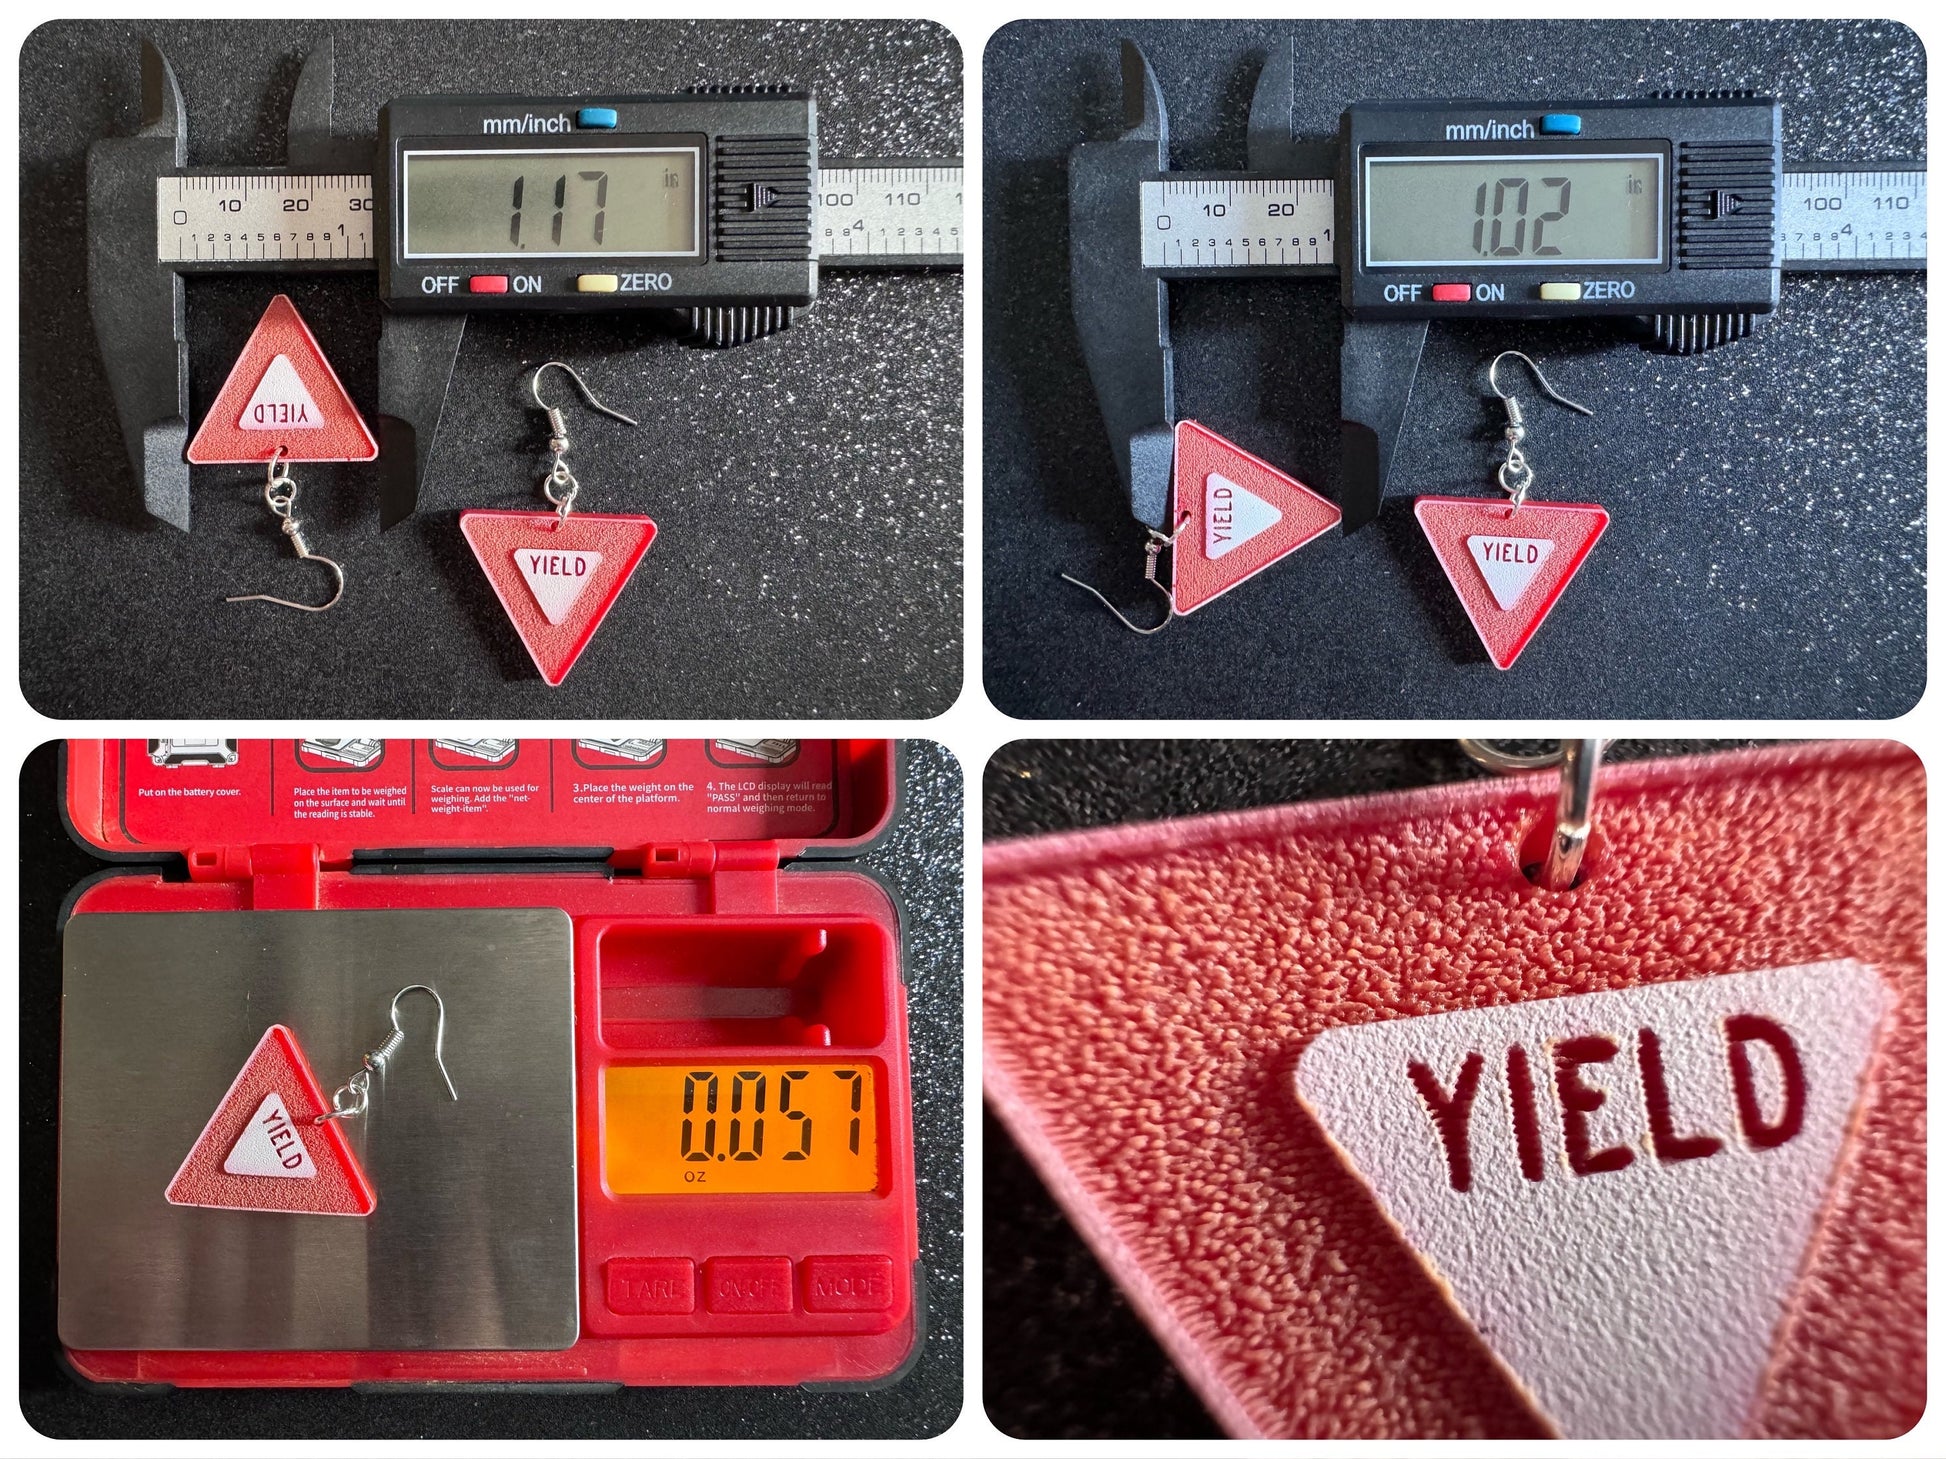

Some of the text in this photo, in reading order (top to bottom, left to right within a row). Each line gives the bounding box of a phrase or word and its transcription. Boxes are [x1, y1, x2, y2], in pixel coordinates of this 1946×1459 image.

[484, 114, 571, 133] mm/inch
[1446, 120, 1535, 140] mm/inch
[219, 199, 373, 212] 10 20 30
[819, 194, 853, 206] 100
[885, 193, 920, 205] 110
[1804, 197, 1908, 210] 100 110
[174, 210, 187, 224] 0
[510, 171, 608, 249] 1.17
[1203, 204, 1294, 216] 10 20
[1472, 178, 1571, 257] 1.02
[853, 220, 864, 231] 4
[1157, 215, 1171, 230] 0
[258, 233, 264, 241] 5
[338, 224, 345, 236] 1
[1259, 238, 1265, 246] 6
[1276, 238, 1282, 246] 7
[1292, 238, 1299, 246] 8
[1324, 229, 1330, 241] 1
[1796, 233, 1803, 241] 7
[1841, 224, 1852, 235] 4
[1886, 232, 1892, 240] 2
[1903, 232, 1910, 240] 3
[422, 273, 672, 294] OFF ON ZERO
[1384, 281, 1635, 302] OFF ON ZERO
[254, 403, 309, 422] YIELD
[1213, 487, 1233, 544] YIELD
[1483, 542, 1539, 564] YIELD
[530, 555, 587, 576] YIELD
[168, 788, 182, 796] the
[184, 788, 214, 798] battery
[332, 787, 350, 795] item
[362, 787, 371, 795] be
[374, 786, 407, 796] weighed
[573, 783, 608, 792] 3.Place
[611, 783, 626, 791] the
[629, 783, 661, 793] weight
[678, 783, 694, 791] the
[707, 782, 832, 792] 4. The LCD display will read
[306, 799, 319, 807] the
[321, 798, 349, 806] surface
[351, 798, 366, 806] and
[368, 798, 385, 806] wait
[388, 798, 406, 806] until
[431, 795, 472, 804] weighing.
[573, 794, 680, 804] center of the platform.
[743, 793, 760, 801] and
[763, 793, 784, 801] then
[817, 793, 826, 801] to
[294, 810, 307, 818] the
[309, 809, 339, 820] reading
[349, 809, 375, 817] stable.
[707, 804, 815, 814] normal weighing mode.
[1406, 1013, 1810, 1193] YIELD
[681, 1071, 862, 1162] 0.057
[262, 1109, 302, 1169] YIELD
